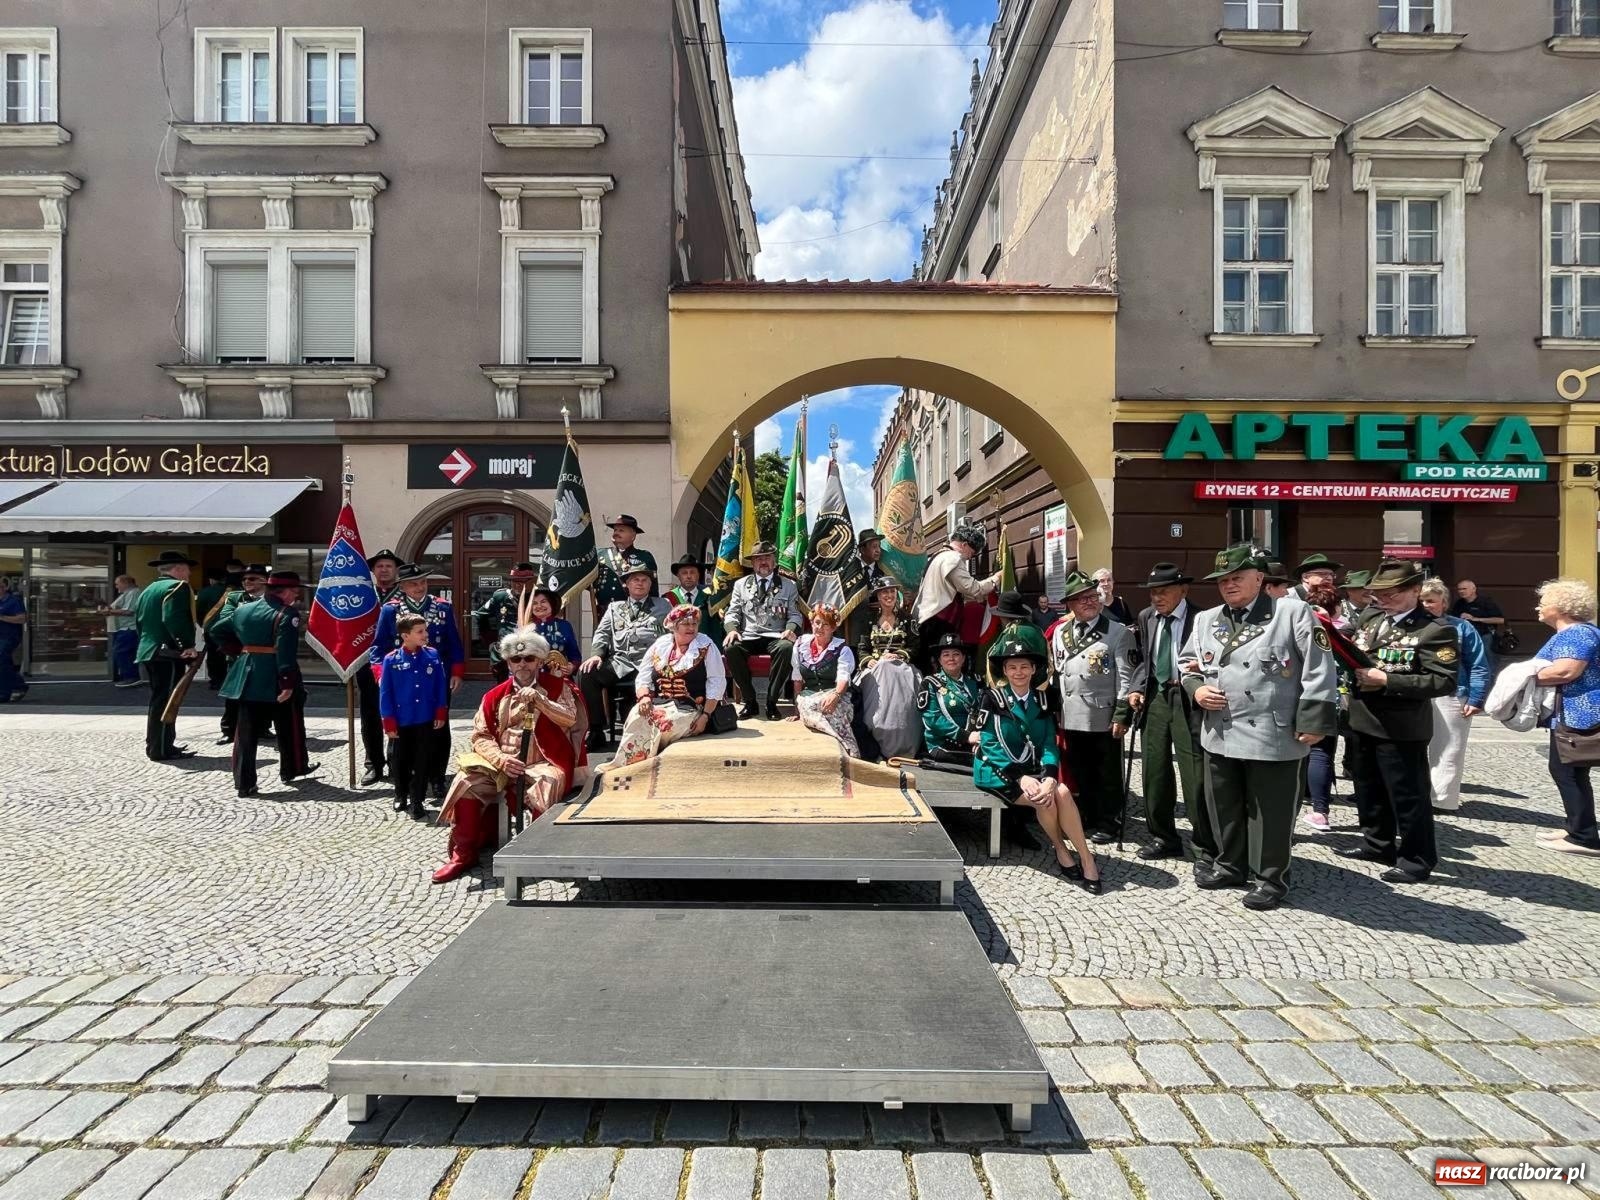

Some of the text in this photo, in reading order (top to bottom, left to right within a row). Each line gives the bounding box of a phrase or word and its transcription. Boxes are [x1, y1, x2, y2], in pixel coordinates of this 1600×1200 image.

[1162, 411, 1547, 462] APTEKA
[66, 446, 151, 476] Lodów
[160, 443, 270, 475] Gałeczka
[488, 452, 535, 478] moraj
[1415, 465, 1540, 479] POD RÓŻAMI
[1205, 484, 1258, 496] RYNEK
[1262, 485, 1280, 496] 12
[1292, 485, 1366, 497] CENTRUM
[1370, 486, 1511, 499] FARMACEUTYCZNE
